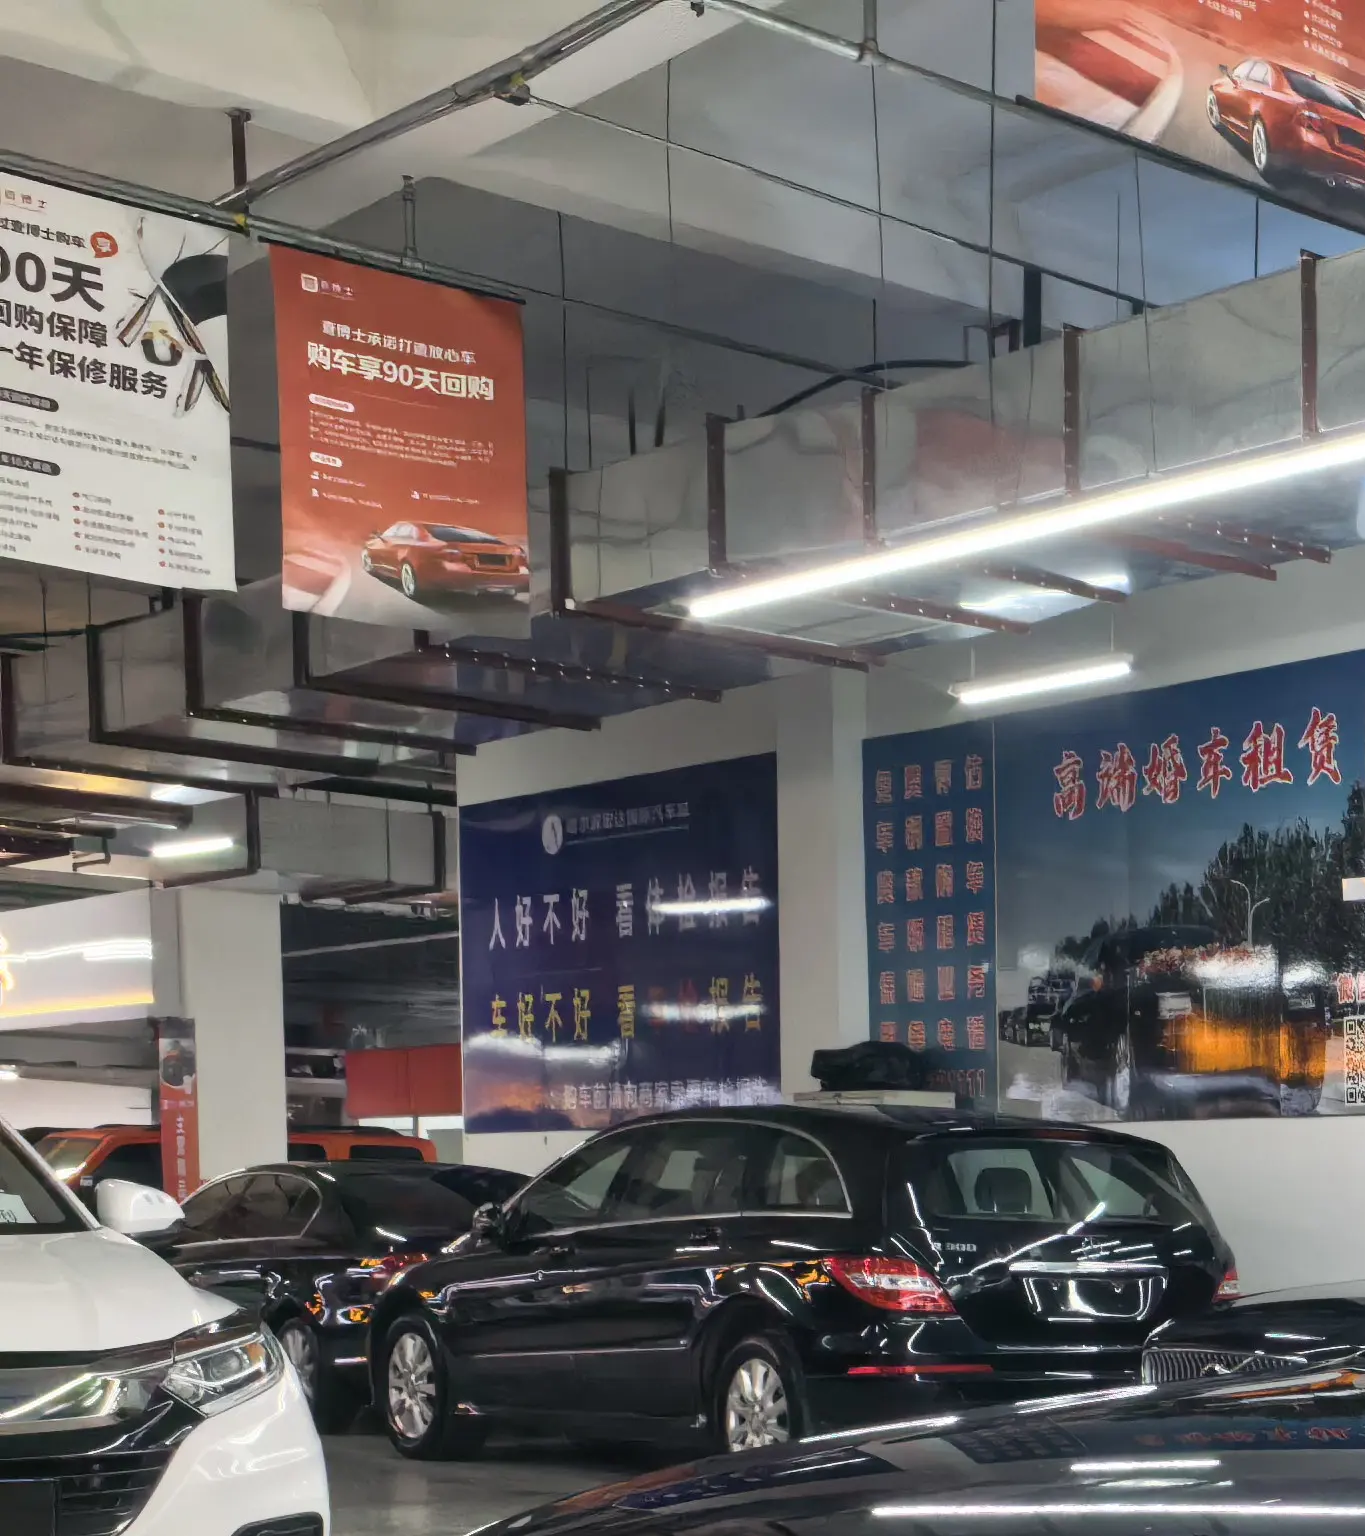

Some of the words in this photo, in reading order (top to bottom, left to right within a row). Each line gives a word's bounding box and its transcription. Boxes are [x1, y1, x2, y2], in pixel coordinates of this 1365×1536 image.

[307, 342, 494, 401] 购车享90天回购
[1052, 706, 1342, 820] 高端婚车租赁
[489, 888, 589, 950] 人好不好
[491, 988, 591, 1044] 车好不好
